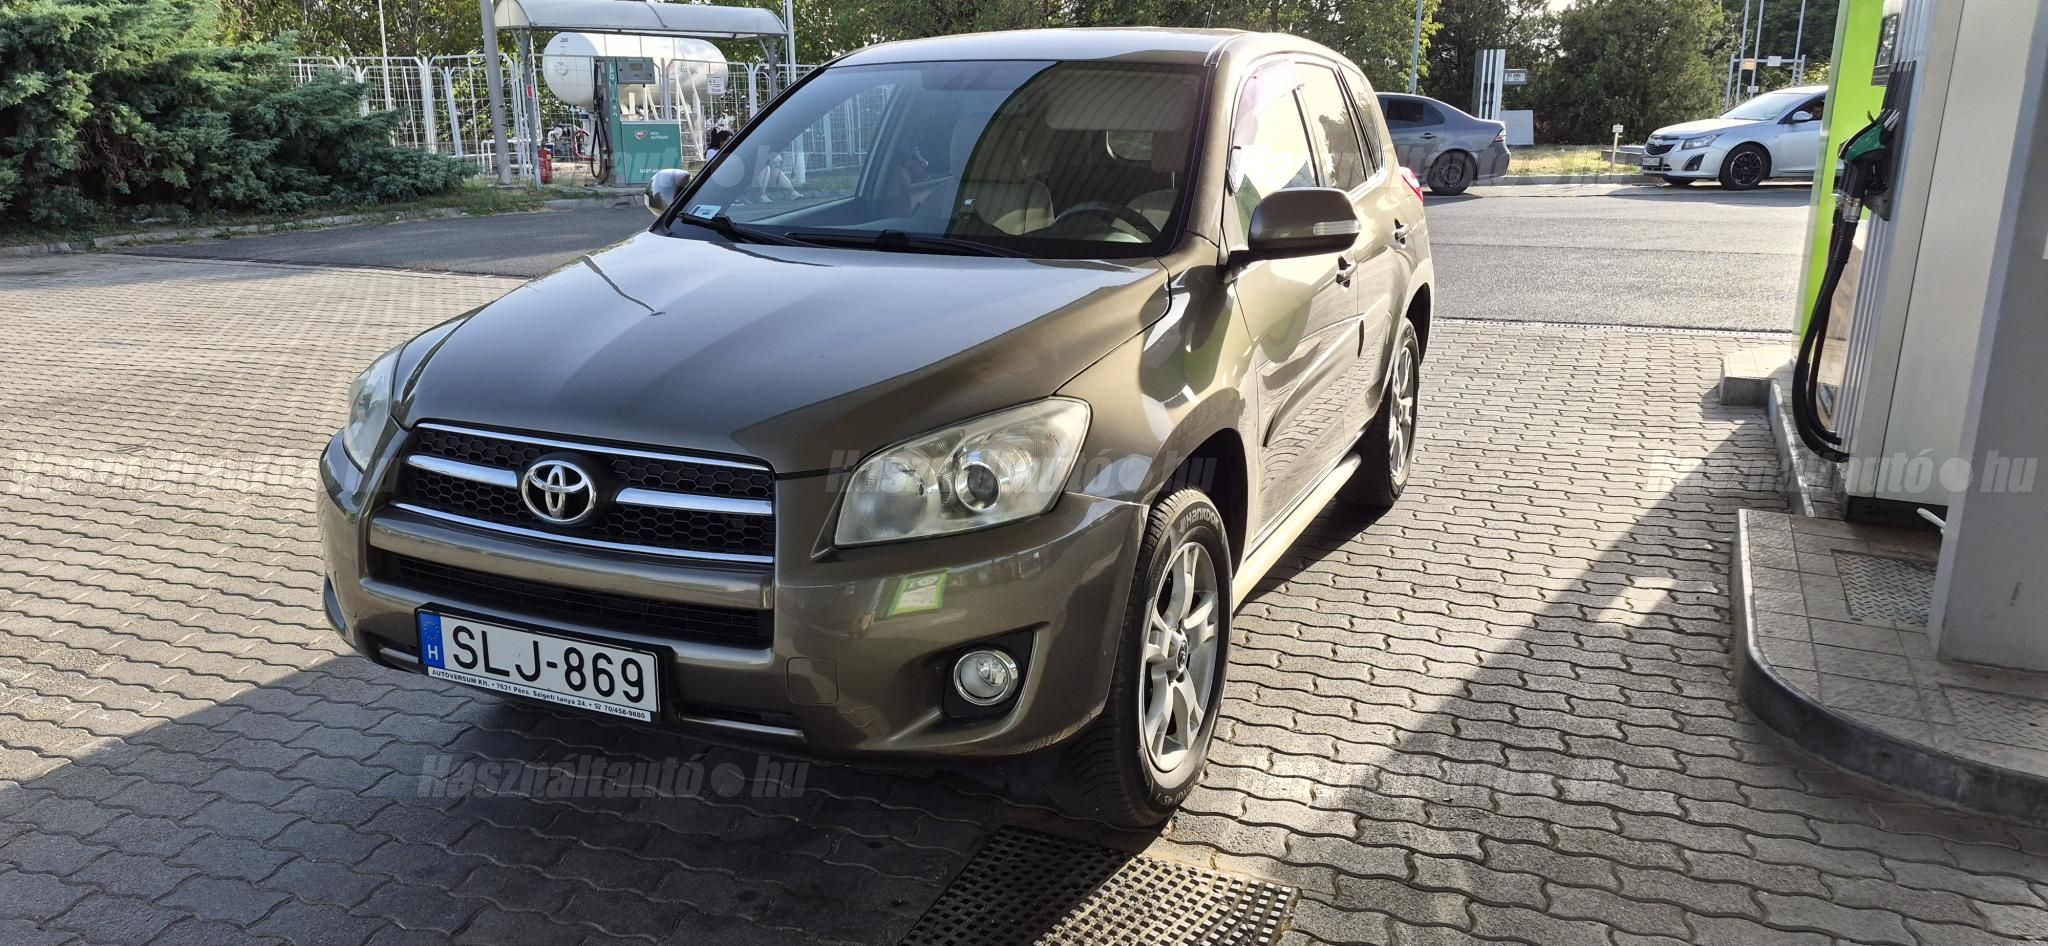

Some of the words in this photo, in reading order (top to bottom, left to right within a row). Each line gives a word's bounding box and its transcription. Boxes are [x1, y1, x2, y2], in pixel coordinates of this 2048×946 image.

[427, 645, 439, 662] H
[452, 625, 645, 704] SLJ-869
[432, 669, 477, 684] AUTOVERSUM
[532, 690, 555, 700] Szigeti
[556, 695, 576, 706] tanya
